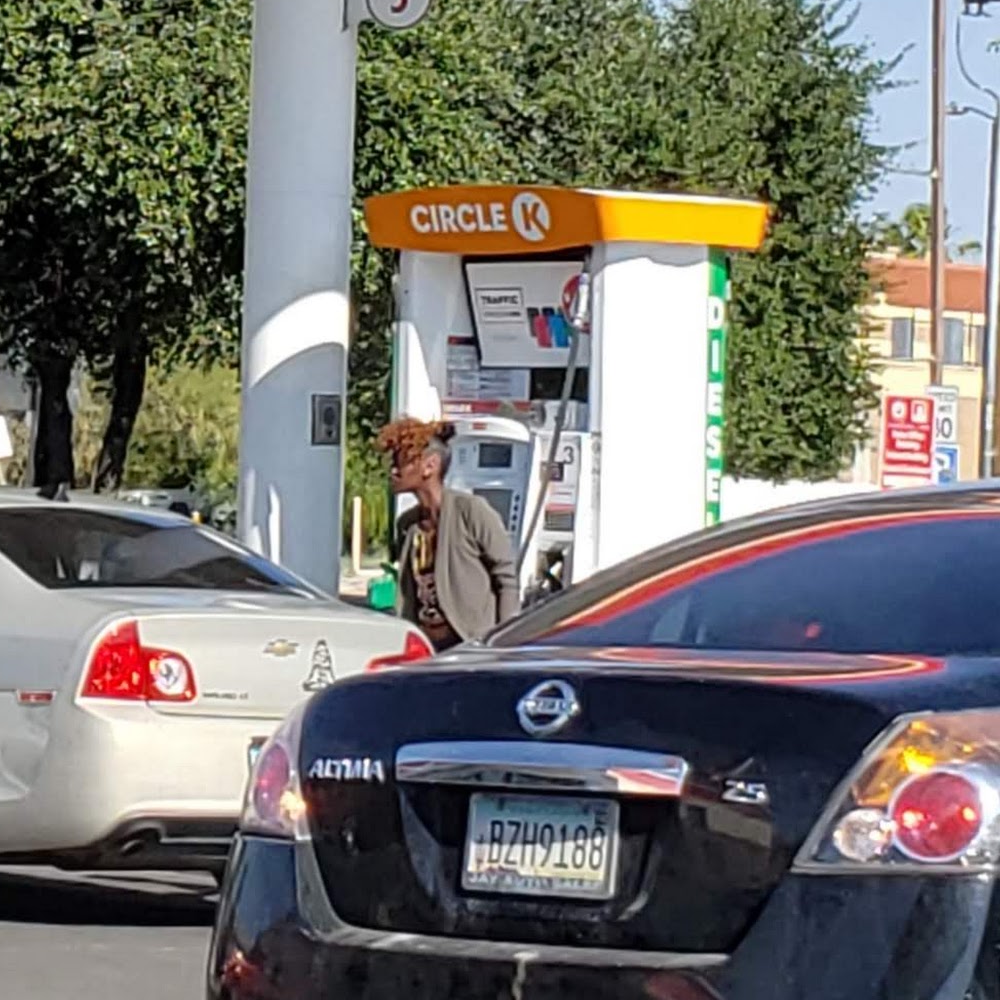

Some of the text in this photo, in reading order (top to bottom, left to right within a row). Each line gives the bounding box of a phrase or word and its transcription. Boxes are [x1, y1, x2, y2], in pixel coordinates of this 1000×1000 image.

[410, 196, 549, 239] CIRCLE K
[562, 446, 574, 464] 3
[487, 820, 606, 870] BZH9188
